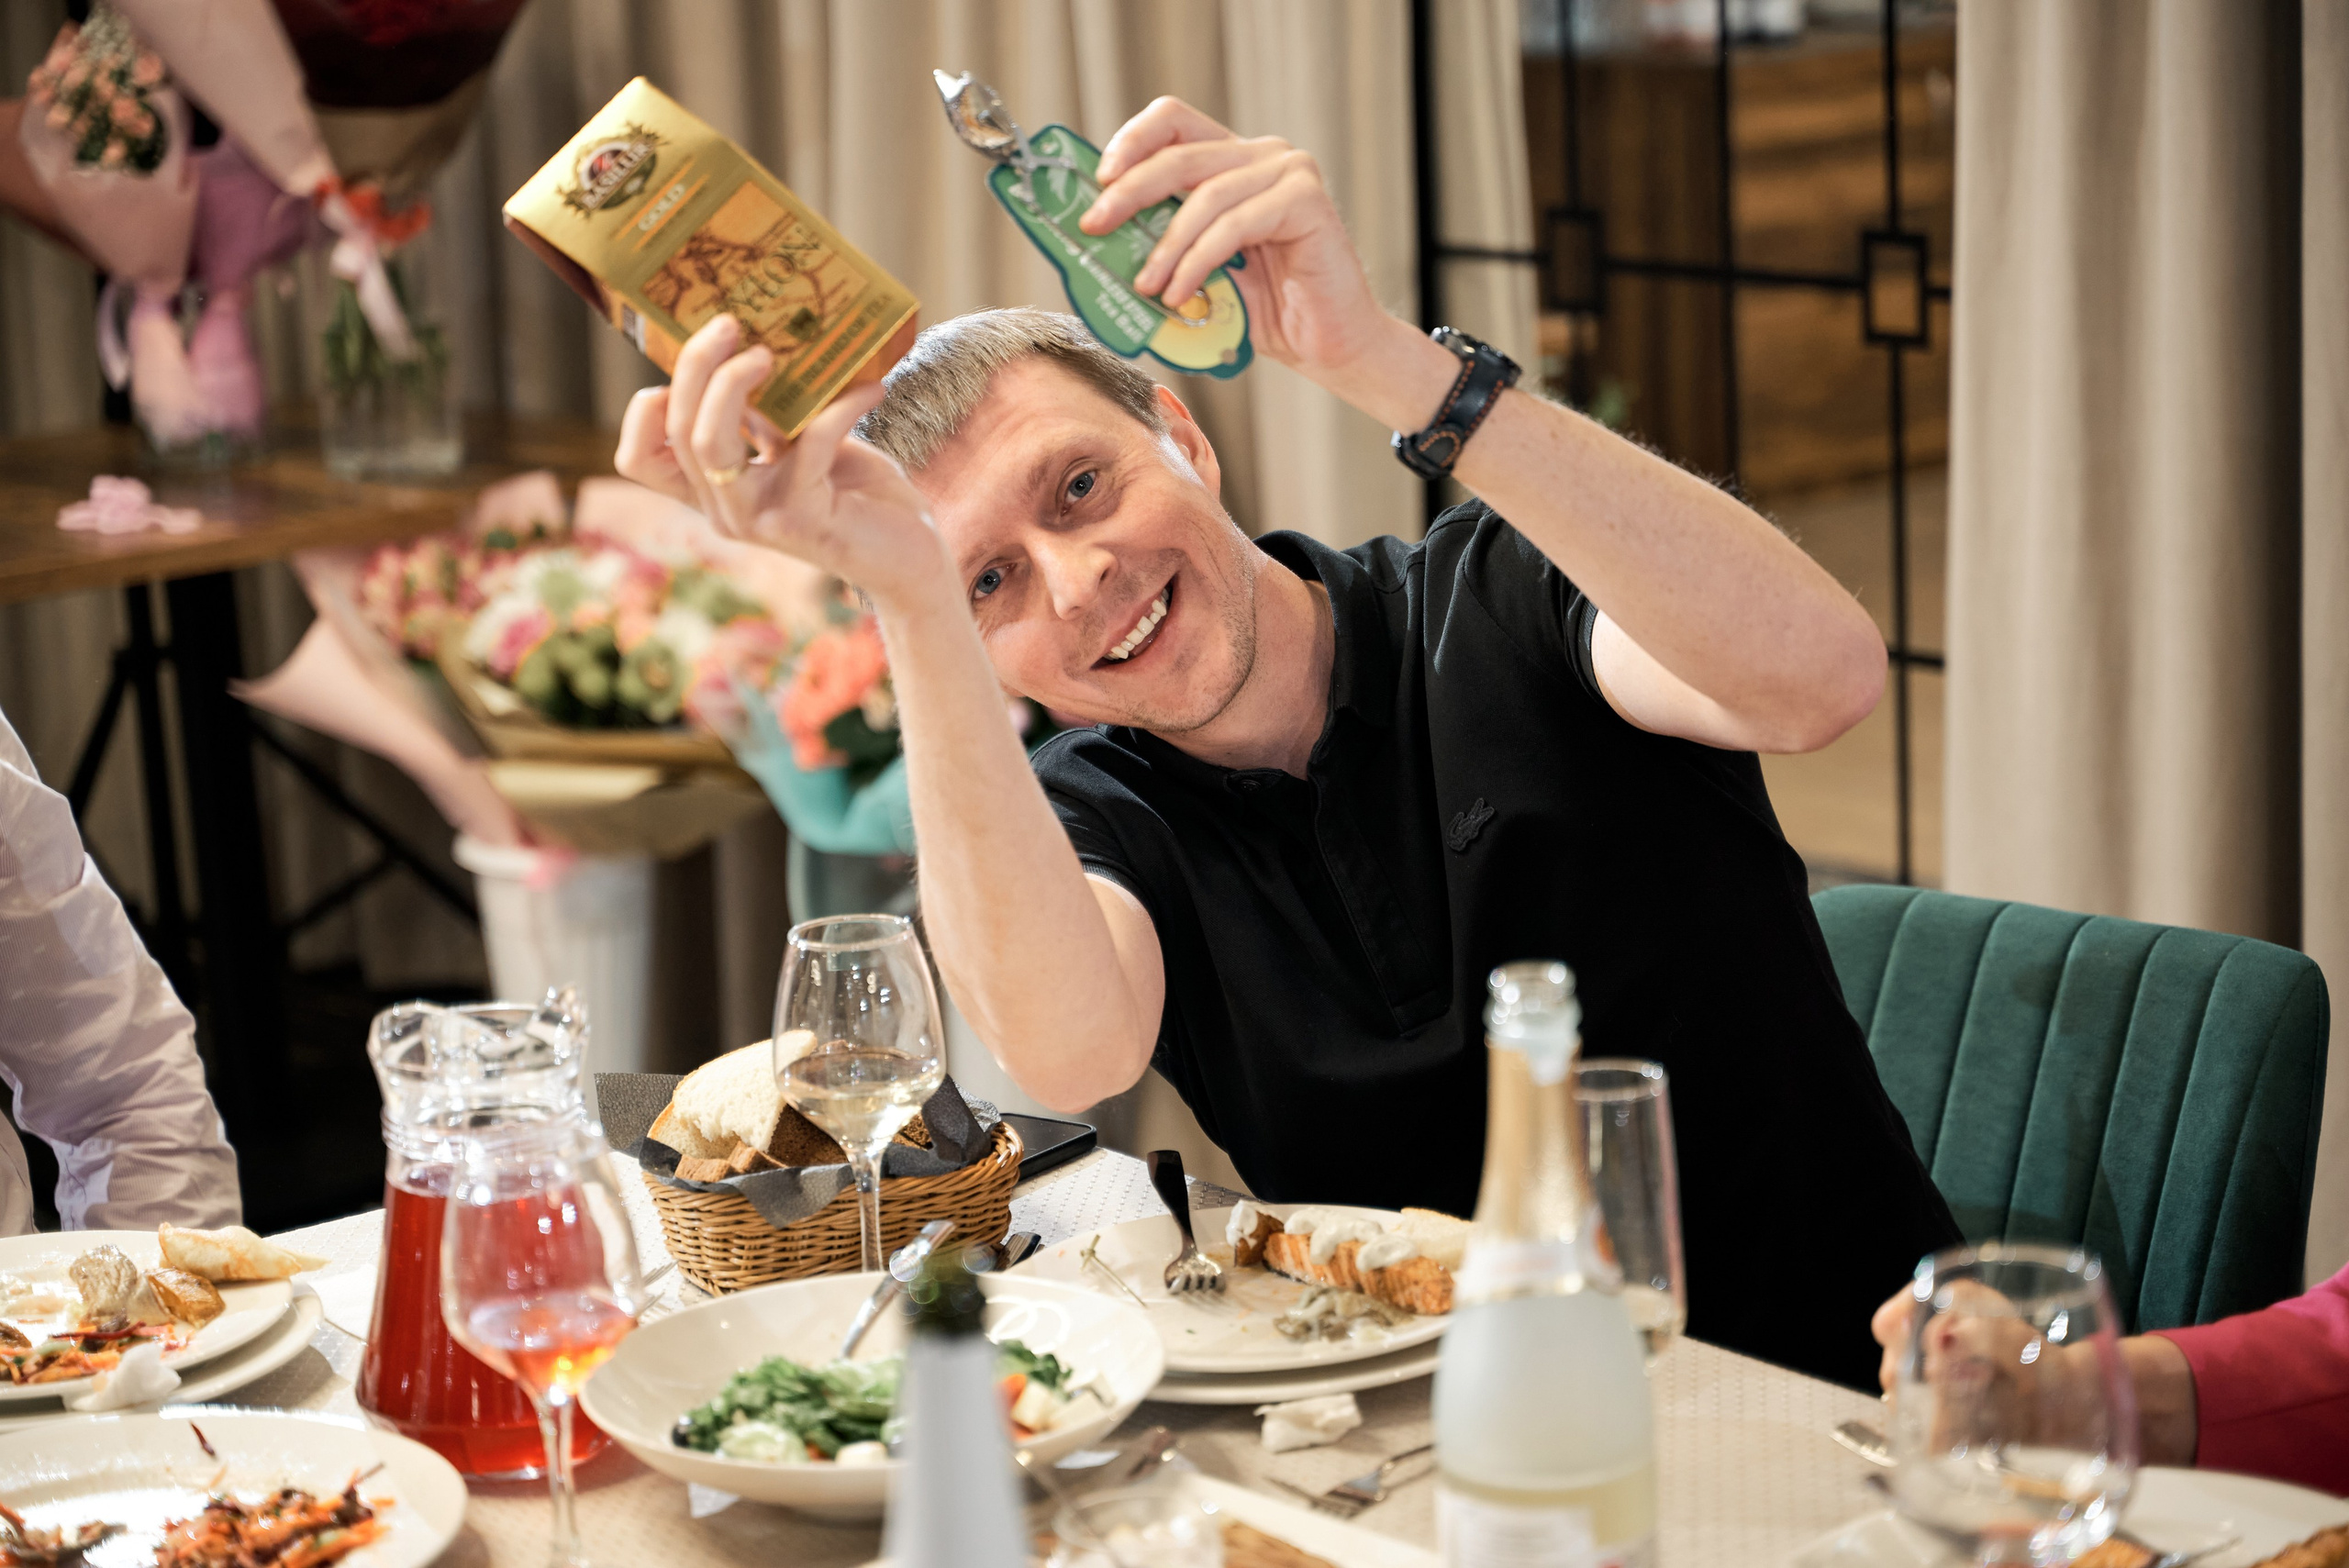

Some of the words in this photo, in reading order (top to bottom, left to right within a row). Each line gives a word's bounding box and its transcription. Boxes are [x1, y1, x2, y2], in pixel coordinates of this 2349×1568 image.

[581, 141, 650, 209] BASILUR
[638, 183, 685, 231] GOLD
[718, 225, 819, 314] YLON
[1096, 291, 1119, 318] Tea
[1115, 313, 1146, 344] Ball
